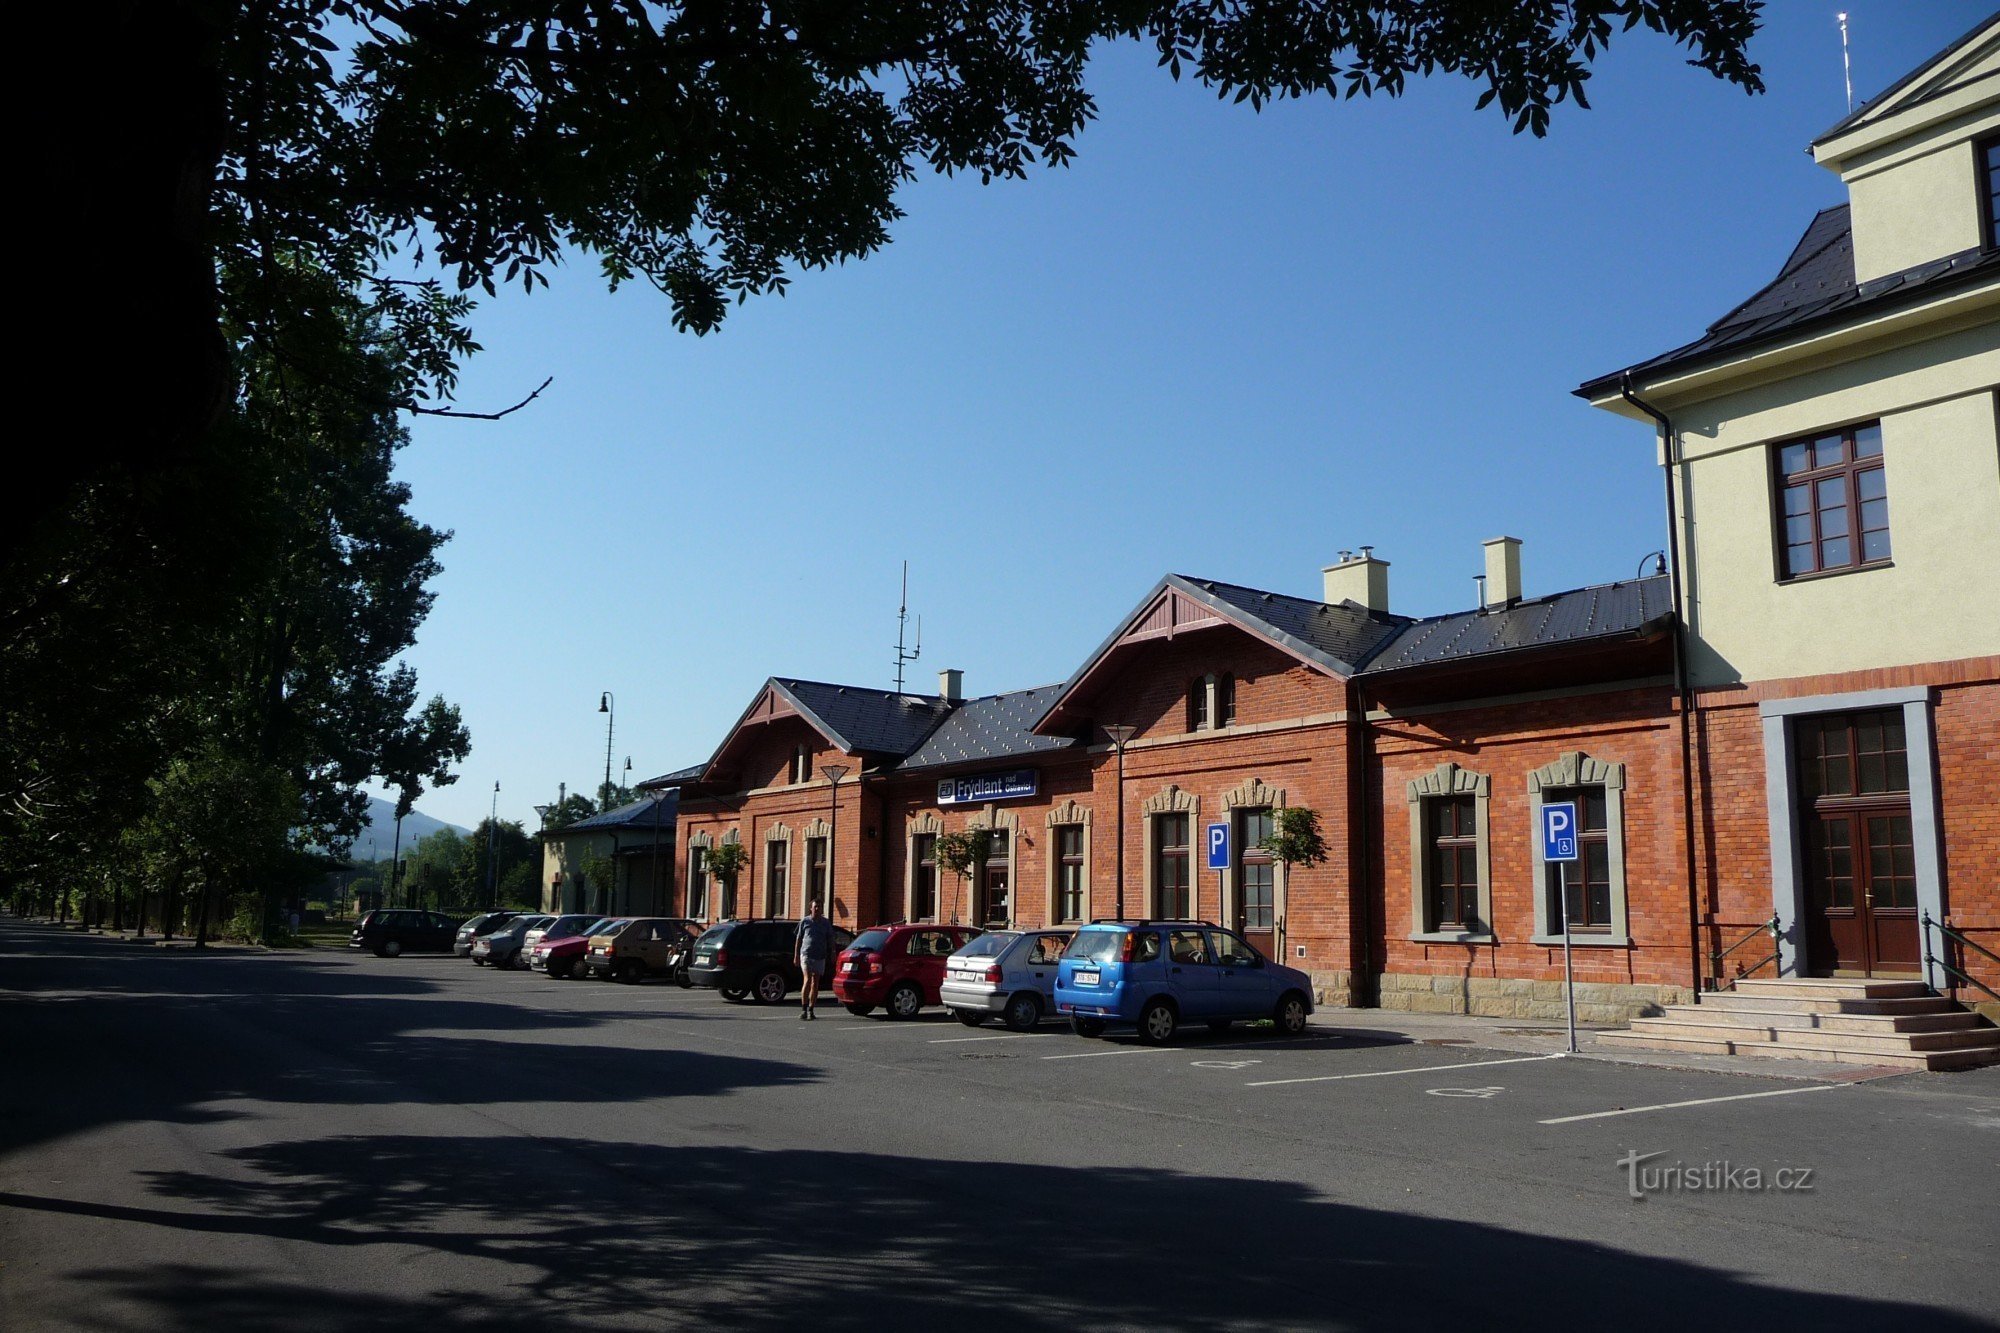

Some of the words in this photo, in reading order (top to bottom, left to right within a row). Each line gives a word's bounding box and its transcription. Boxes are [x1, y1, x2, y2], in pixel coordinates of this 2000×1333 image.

[958, 778, 1002, 800] Frýdlant
[1005, 775, 1017, 783] nad
[1549, 811, 1568, 843] P
[1211, 829, 1224, 855] P
